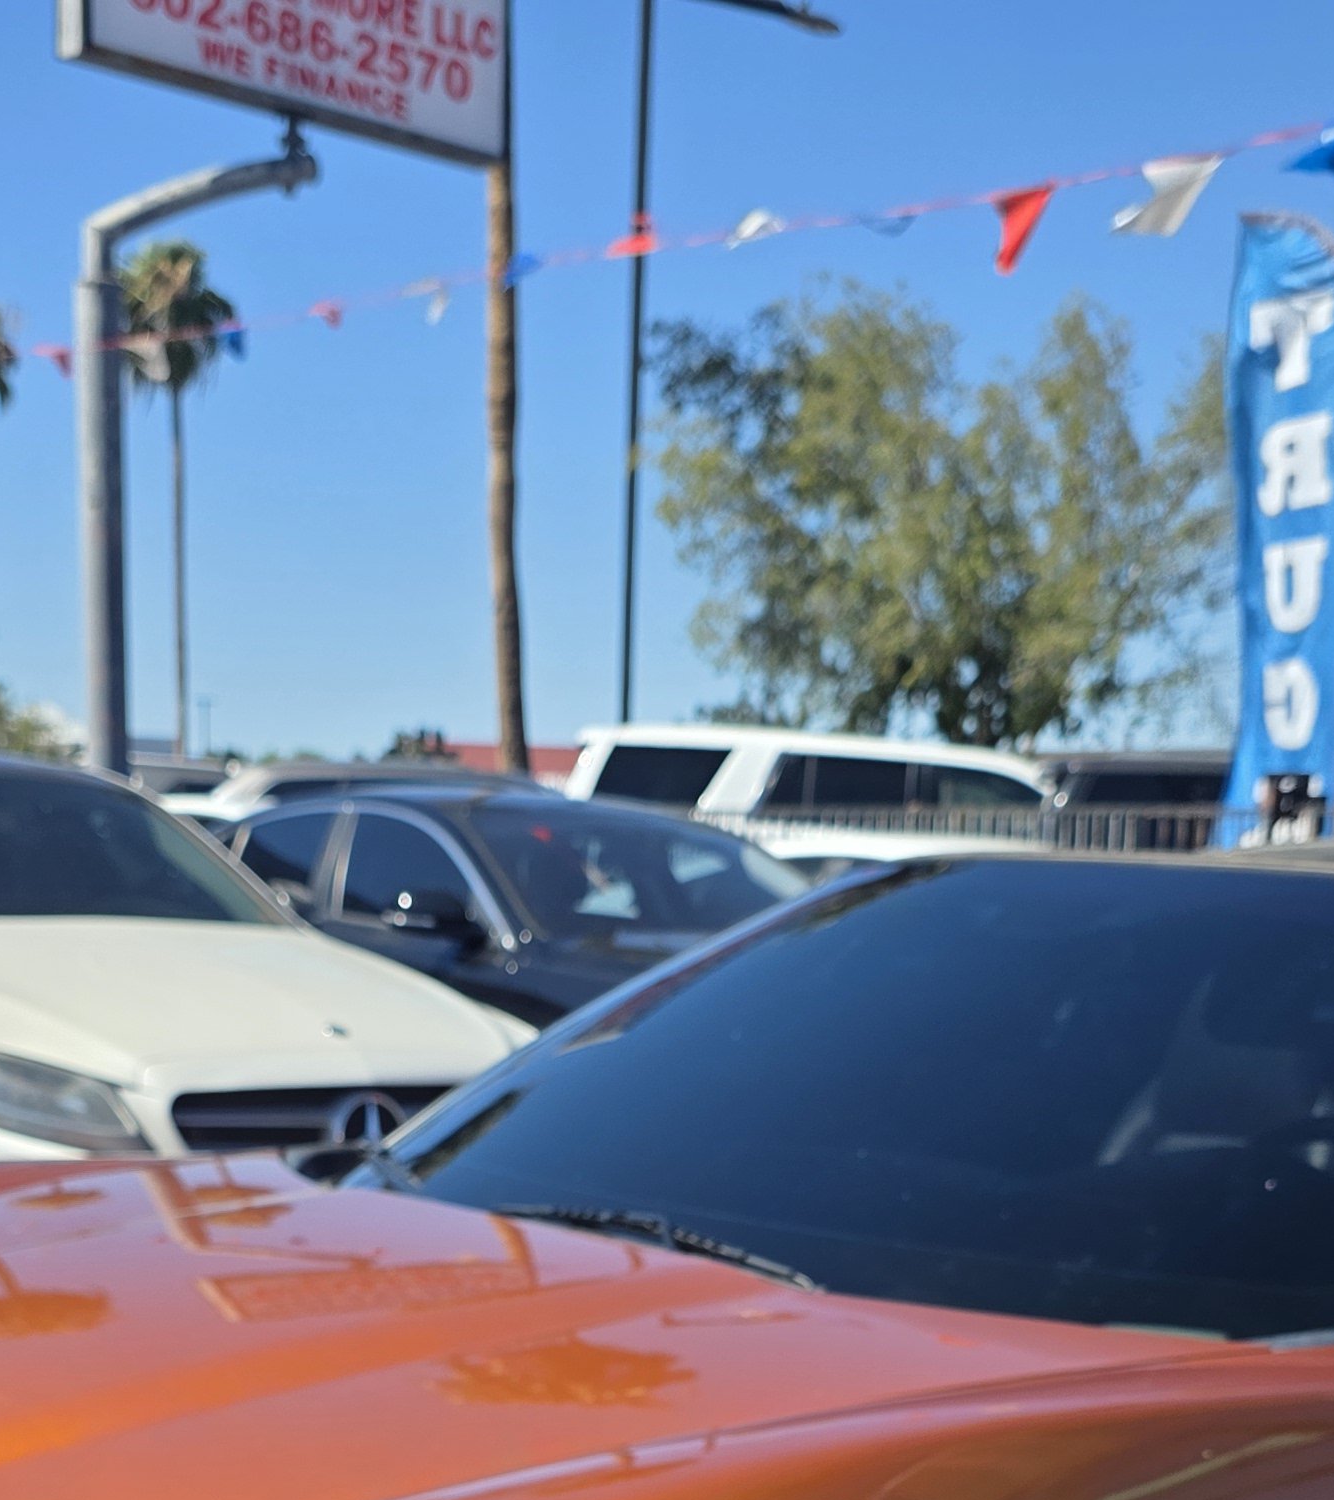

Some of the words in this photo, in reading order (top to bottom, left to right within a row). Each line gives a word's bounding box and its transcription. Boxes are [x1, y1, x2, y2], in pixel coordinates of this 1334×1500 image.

[130, 0, 470, 101] 2-686-2570
[433, 7, 494, 59] LLC
[200, 40, 249, 77] WE
[266, 55, 406, 119] FINANCE
